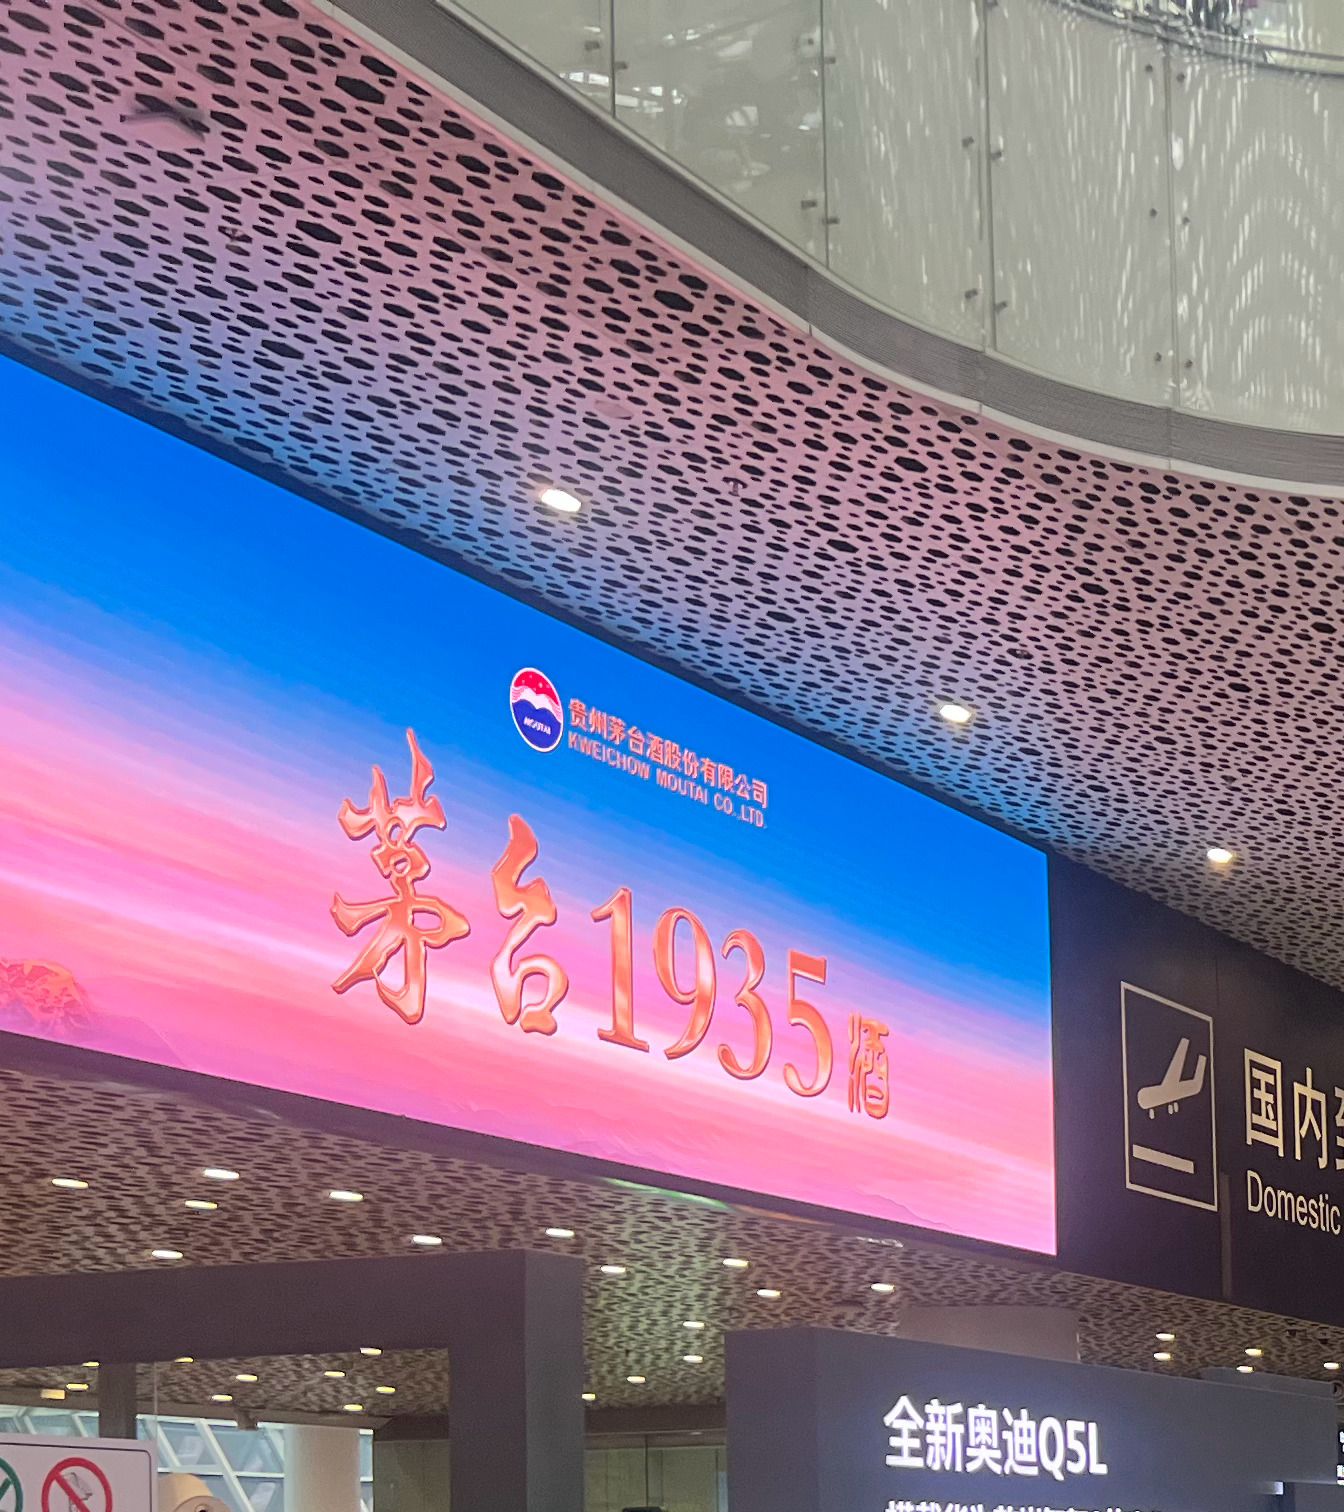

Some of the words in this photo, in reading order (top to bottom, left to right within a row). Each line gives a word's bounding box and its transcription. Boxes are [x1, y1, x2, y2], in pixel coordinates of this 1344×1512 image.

[568, 698, 769, 809] 贵州茅台酒股份有限公司
[568, 731, 651, 780] KWEICHOW
[656, 768, 708, 805] MOUTAI
[1246, 1169, 1341, 1235] Domestic
[883, 1394, 1109, 1481] 全新奥迪Q5L
